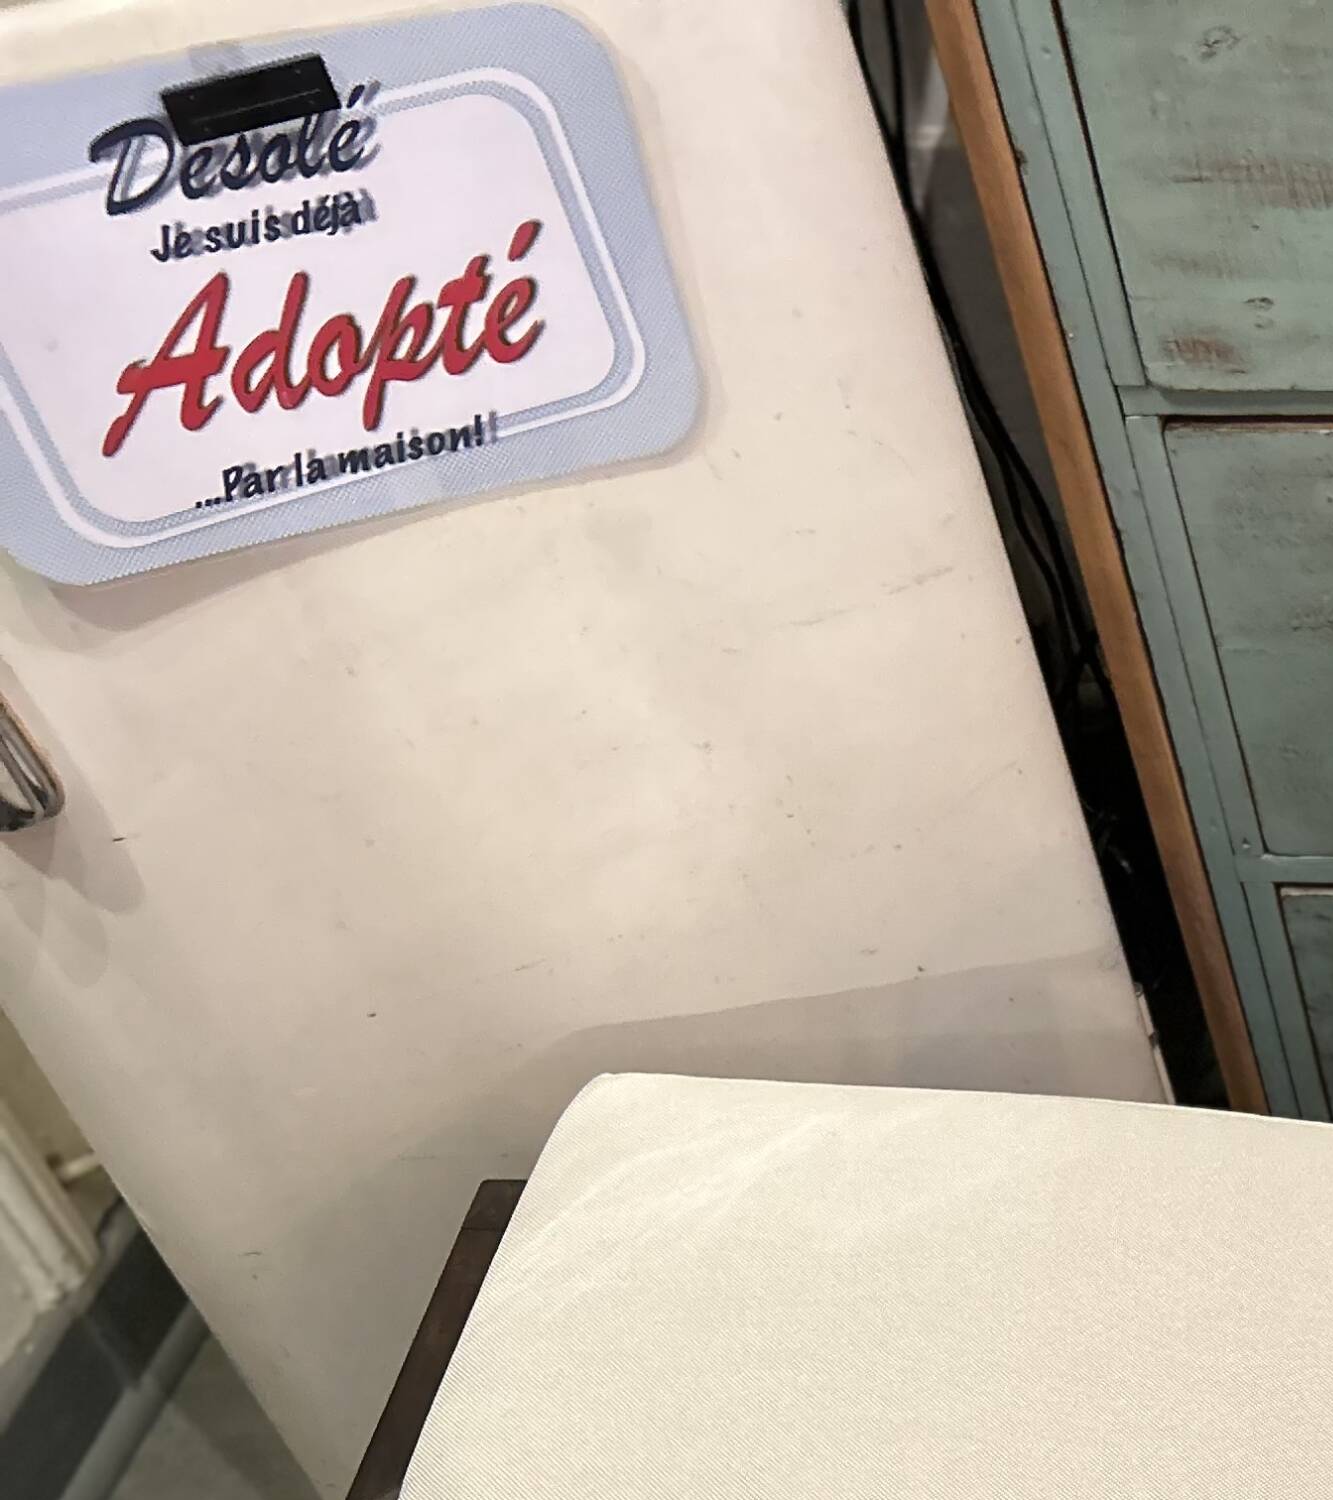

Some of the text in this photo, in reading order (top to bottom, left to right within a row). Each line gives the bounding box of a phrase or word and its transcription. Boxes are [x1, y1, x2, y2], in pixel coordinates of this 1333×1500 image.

[150, 224, 192, 262] Je
[205, 209, 281, 253] suis
[102, 220, 545, 457] Adopté
[294, 452, 328, 487] la
[338, 414, 483, 474] maison!
